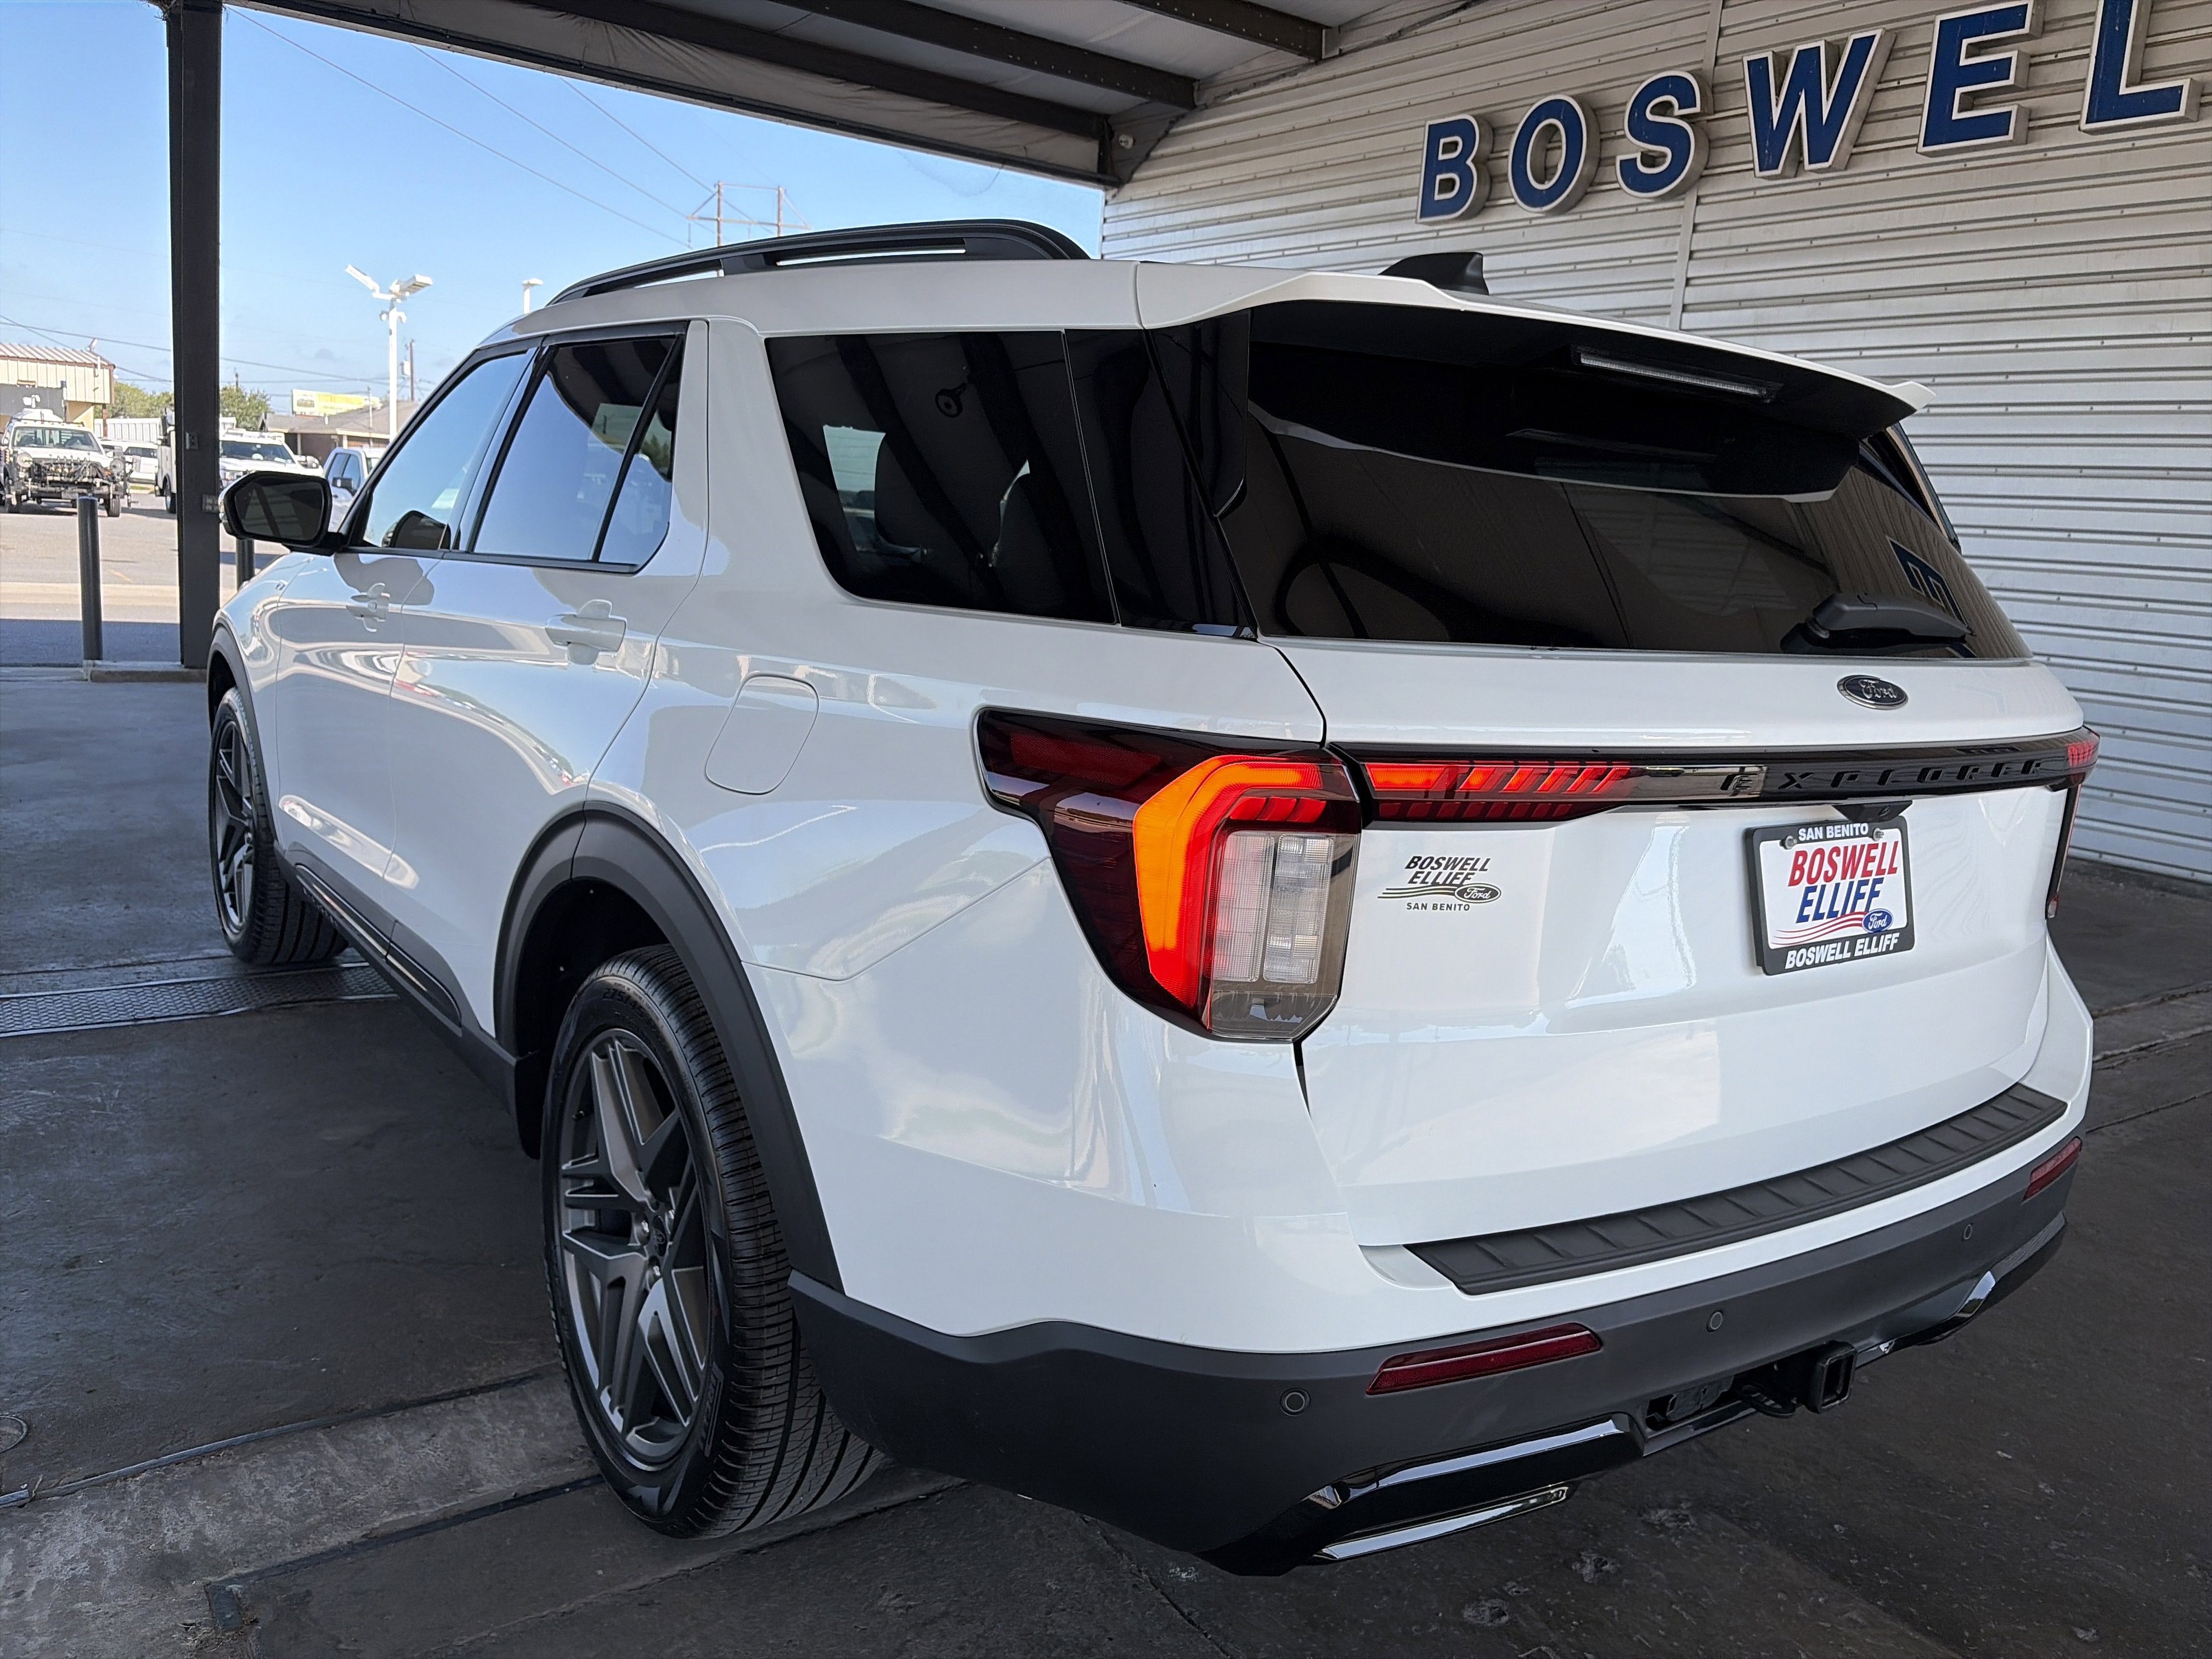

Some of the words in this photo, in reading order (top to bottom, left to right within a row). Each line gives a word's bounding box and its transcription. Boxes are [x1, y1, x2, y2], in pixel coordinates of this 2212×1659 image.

[1798, 827, 1824, 841] SAN
[1826, 822, 1869, 838] BENITO
[1404, 856, 1491, 871] BOSWELL
[1787, 841, 1899, 887] BOSWELL
[1407, 871, 1476, 885] ELLIFF
[1463, 887, 1492, 900] Ford
[1796, 877, 1884, 923] ELLIFF
[1406, 902, 1427, 911] SAN
[1432, 903, 1470, 911] BENITO
[1868, 912, 1888, 929] Ford
[1785, 940, 1852, 969] BOSWELL
[1854, 932, 1900, 957] ELLIFF
